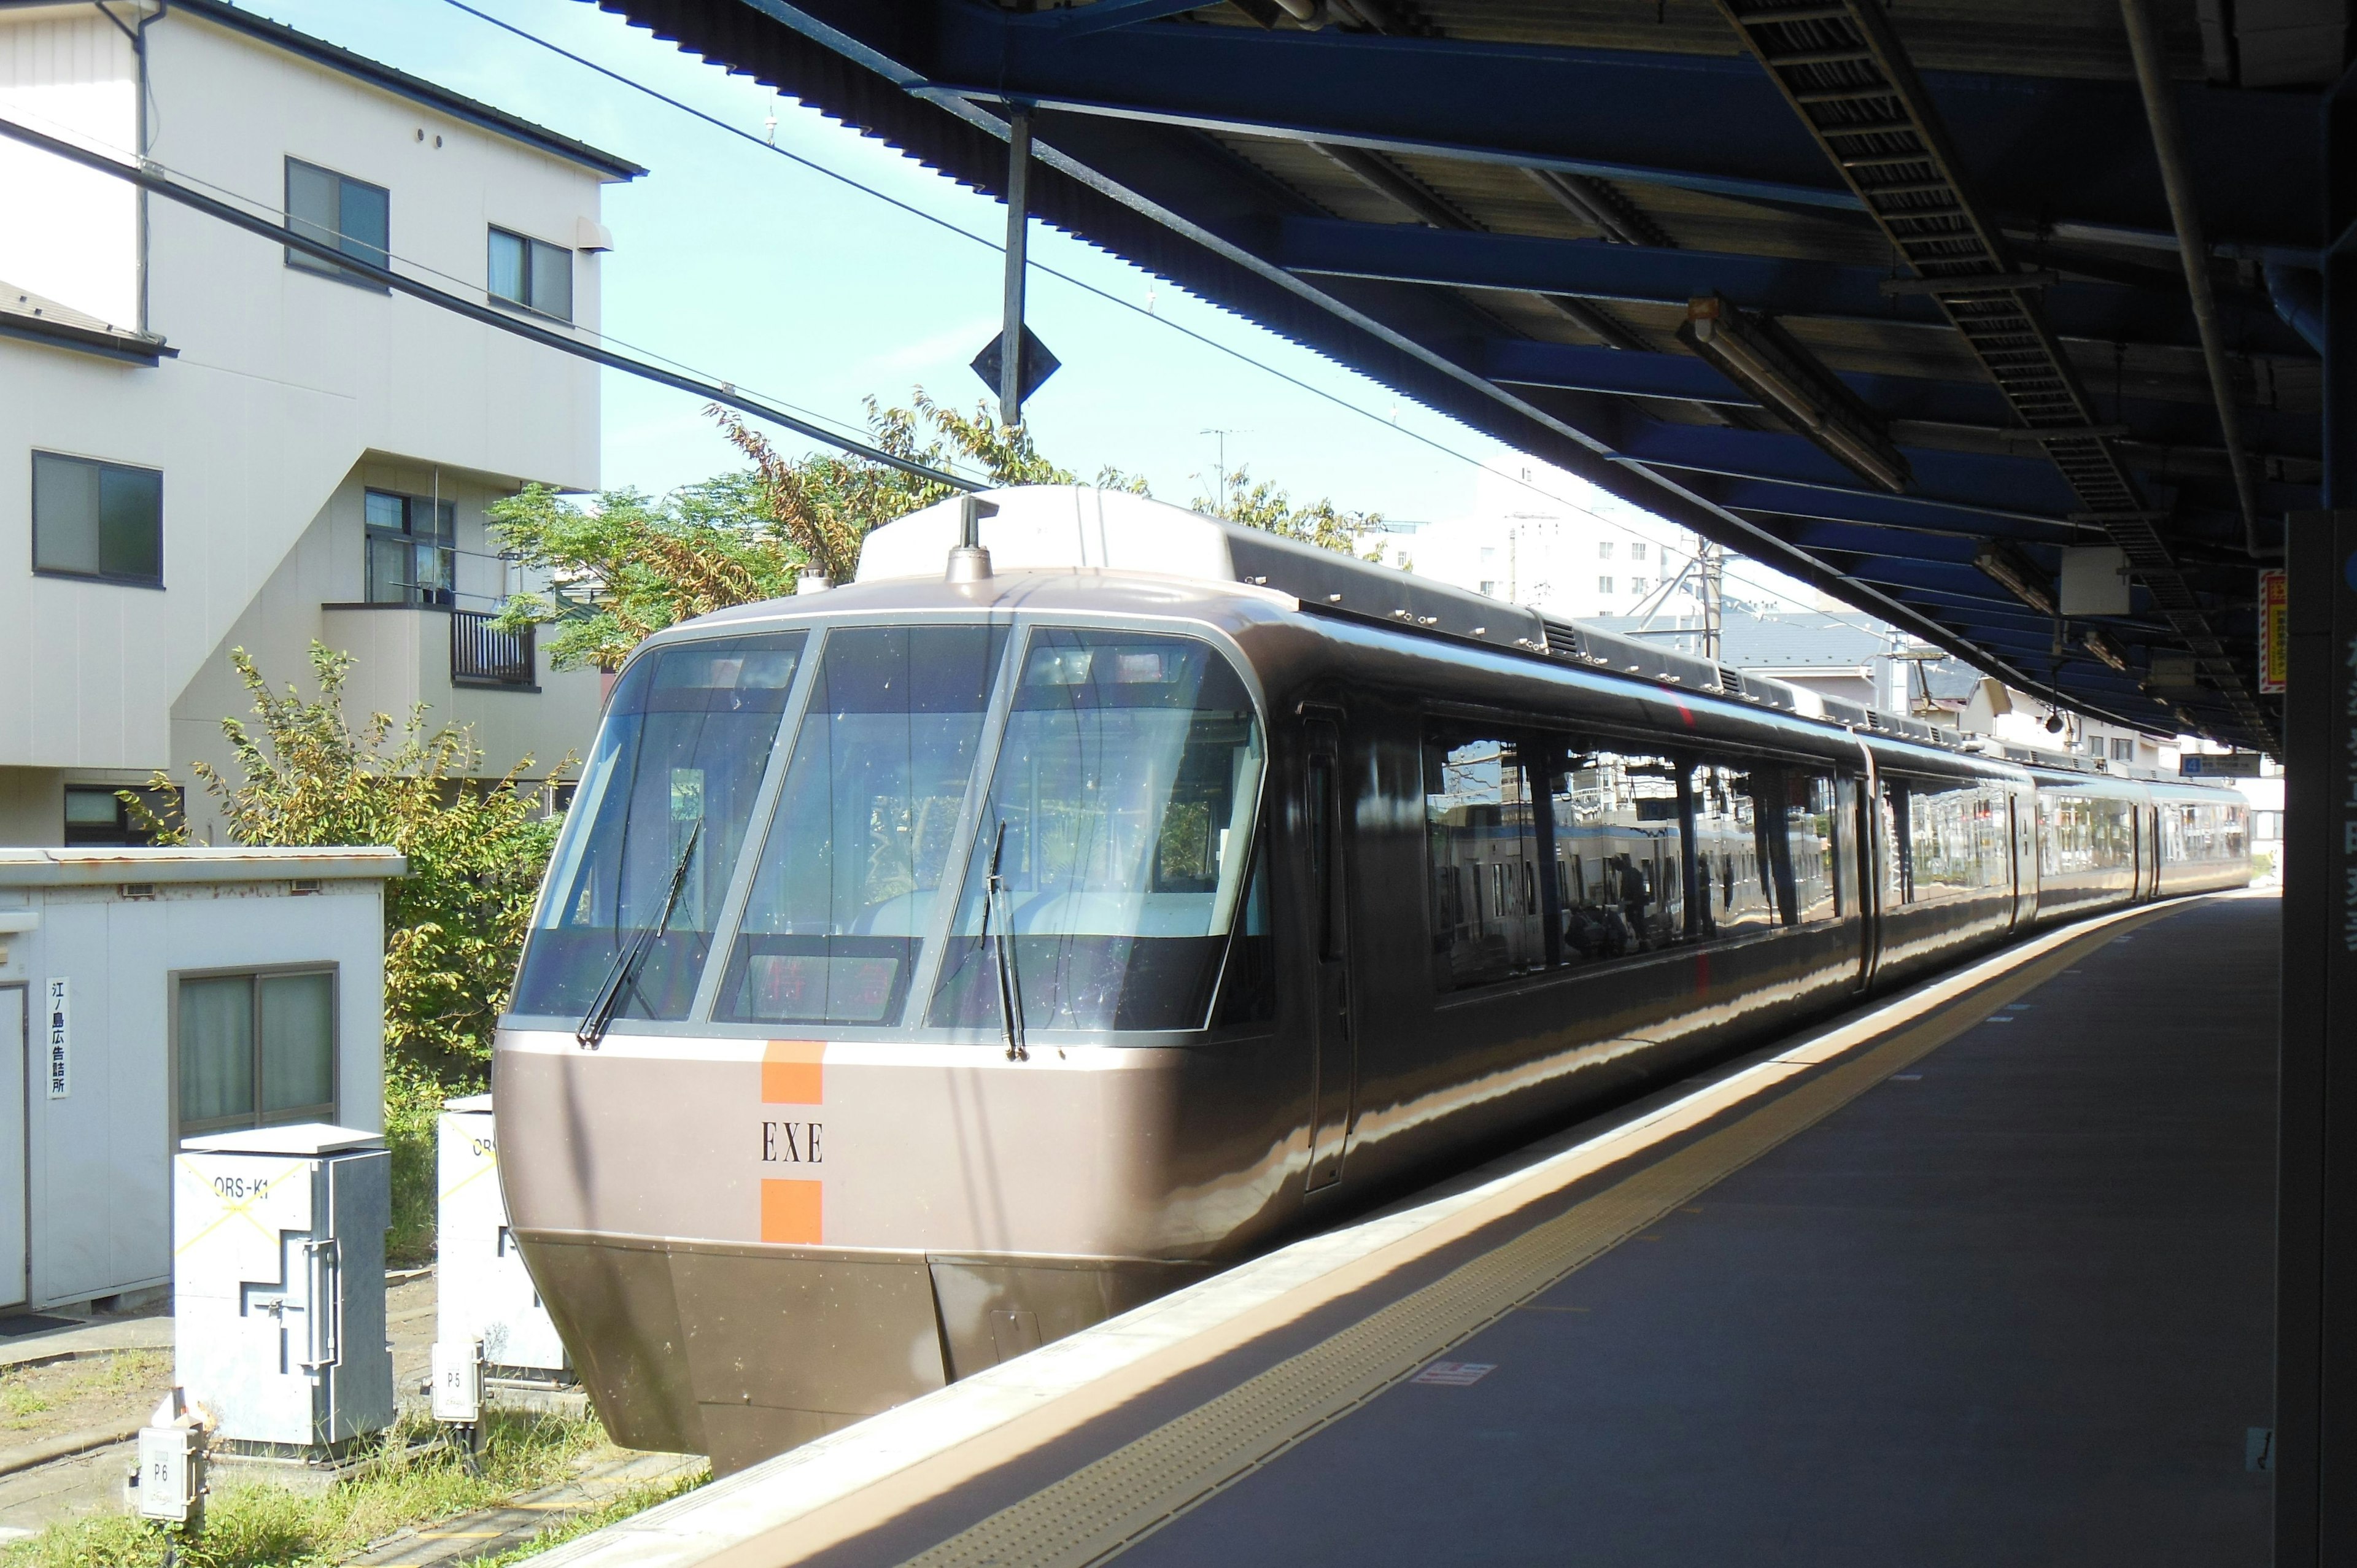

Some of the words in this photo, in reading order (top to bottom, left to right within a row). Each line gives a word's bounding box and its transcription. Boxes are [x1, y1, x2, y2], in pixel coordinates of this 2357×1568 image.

[2188, 759, 2197, 771] 4
[52, 982, 64, 1093] 江ノ島広告詰所
[473, 1138, 496, 1156] OR
[761, 1121, 823, 1163] EXE
[214, 1176, 268, 1199] ORS-K1
